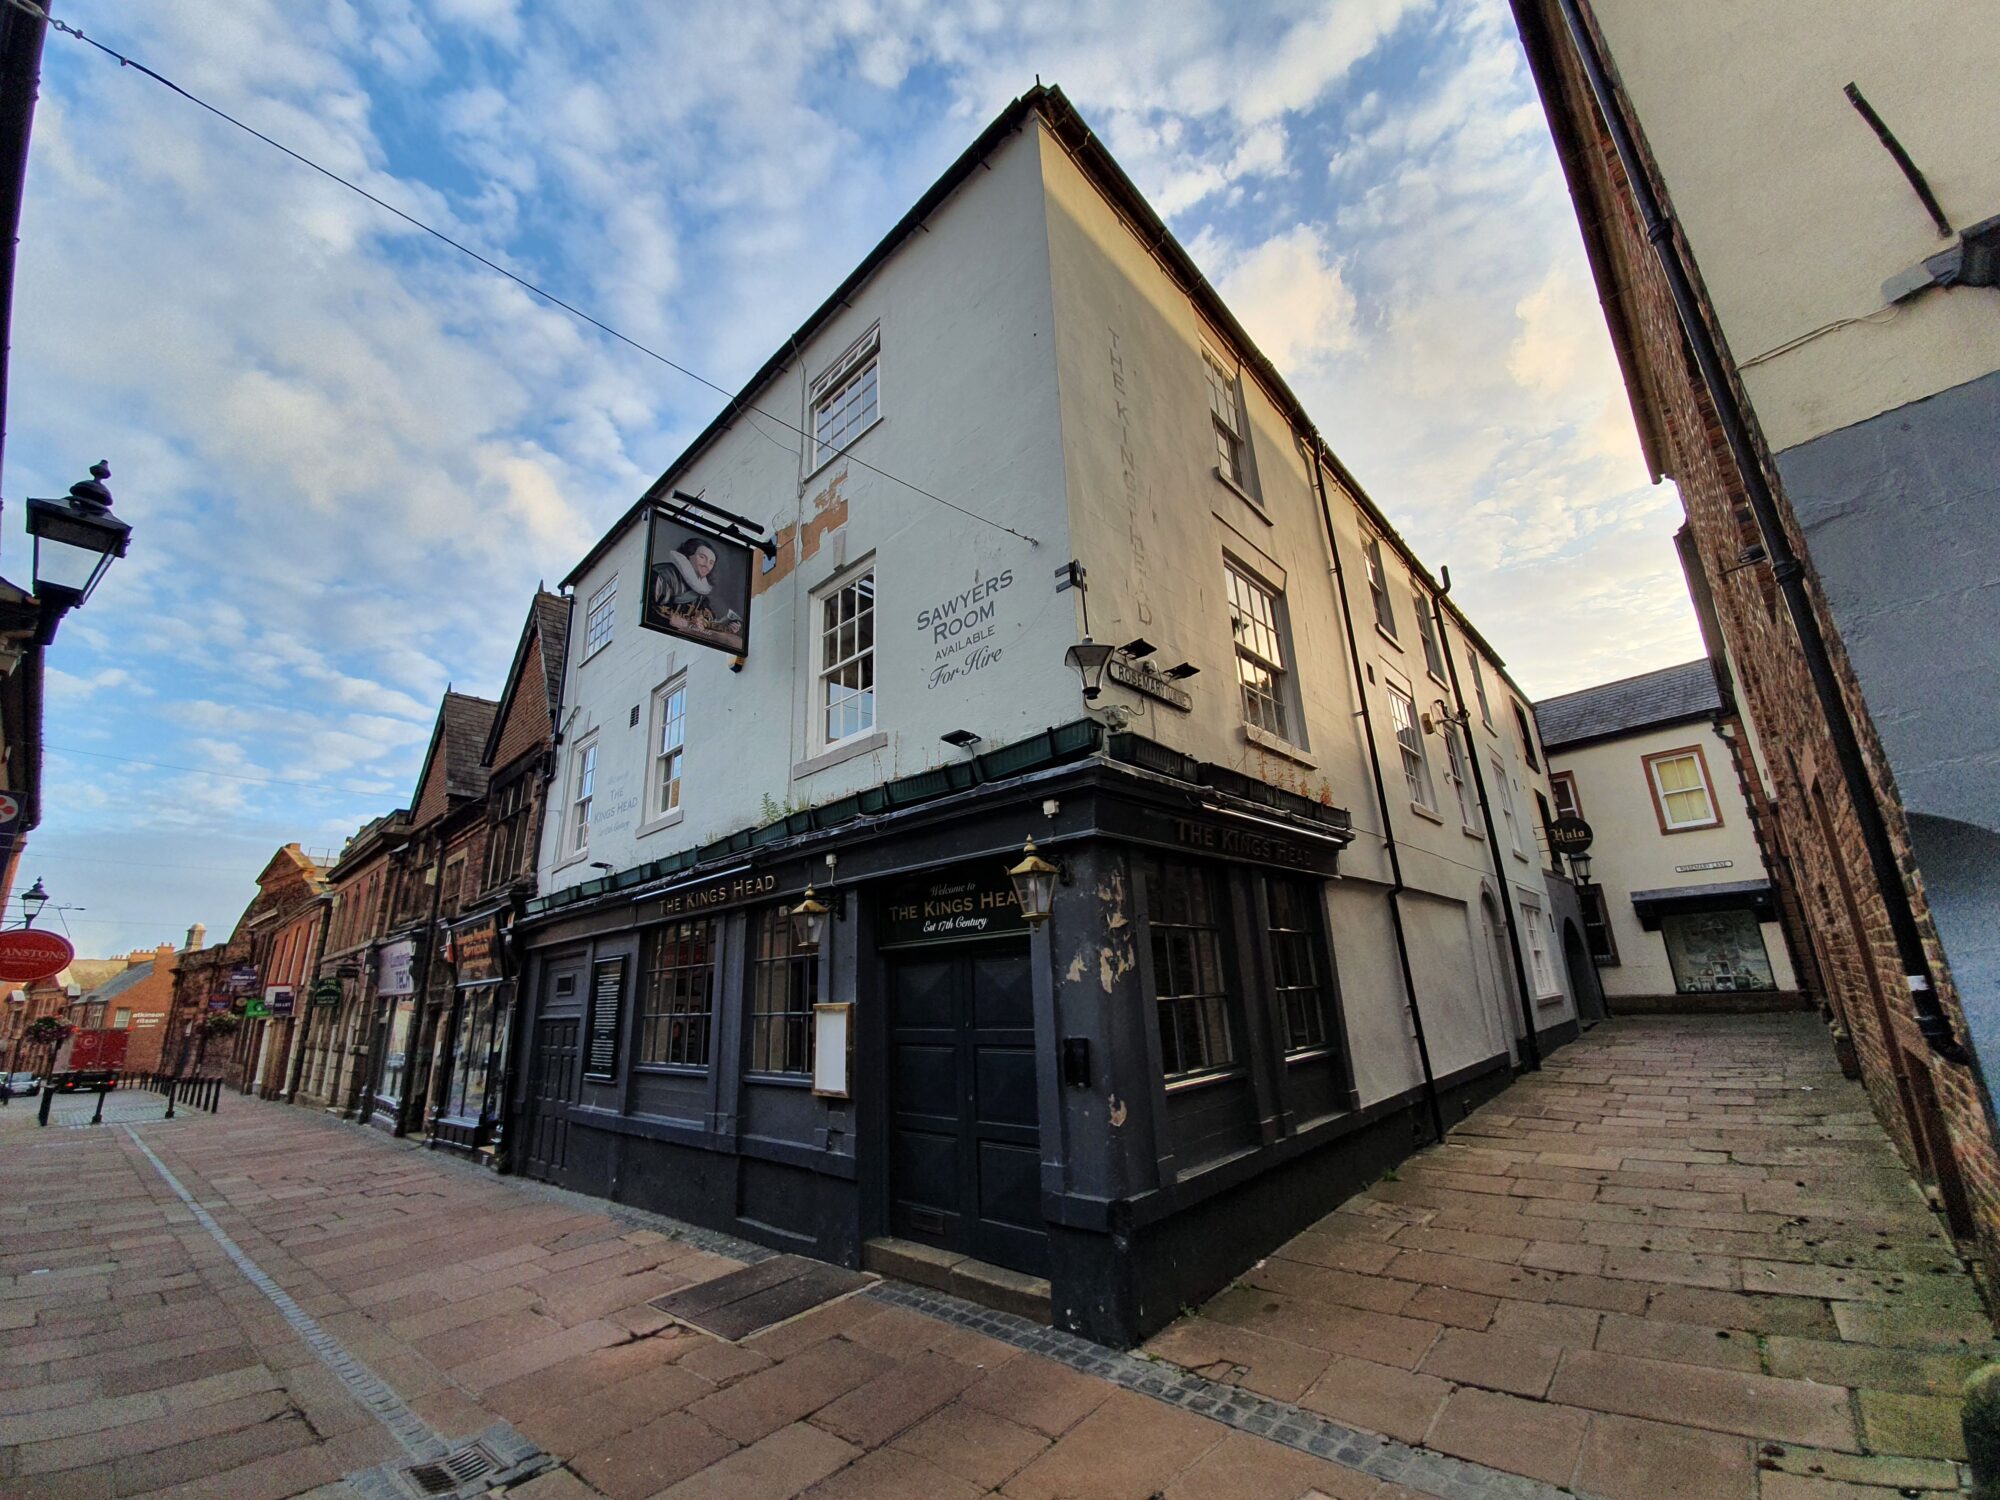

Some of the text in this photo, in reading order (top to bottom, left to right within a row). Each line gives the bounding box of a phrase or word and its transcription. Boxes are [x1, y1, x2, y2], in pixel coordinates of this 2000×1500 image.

[917, 569, 1014, 631] SAWYERS
[933, 600, 995, 645] ROOM
[934, 624, 996, 662] AVAILABLE
[927, 645, 1003, 690] For Hire
[1118, 664, 1166, 698] ROSEMARY
[616, 796, 639, 815] HEAD
[1175, 817, 1215, 847] THE
[1222, 828, 1271, 859] KINGS
[1549, 827, 1585, 842] Halo
[659, 874, 775, 915] THE KINGS HEAD
[929, 882, 976, 897] Welcome to
[889, 905, 918, 923] THE
[924, 897, 974, 918] KINGS
[923, 915, 988, 933] Est 17th Century
[0, 947, 67, 959] ANSTONS
